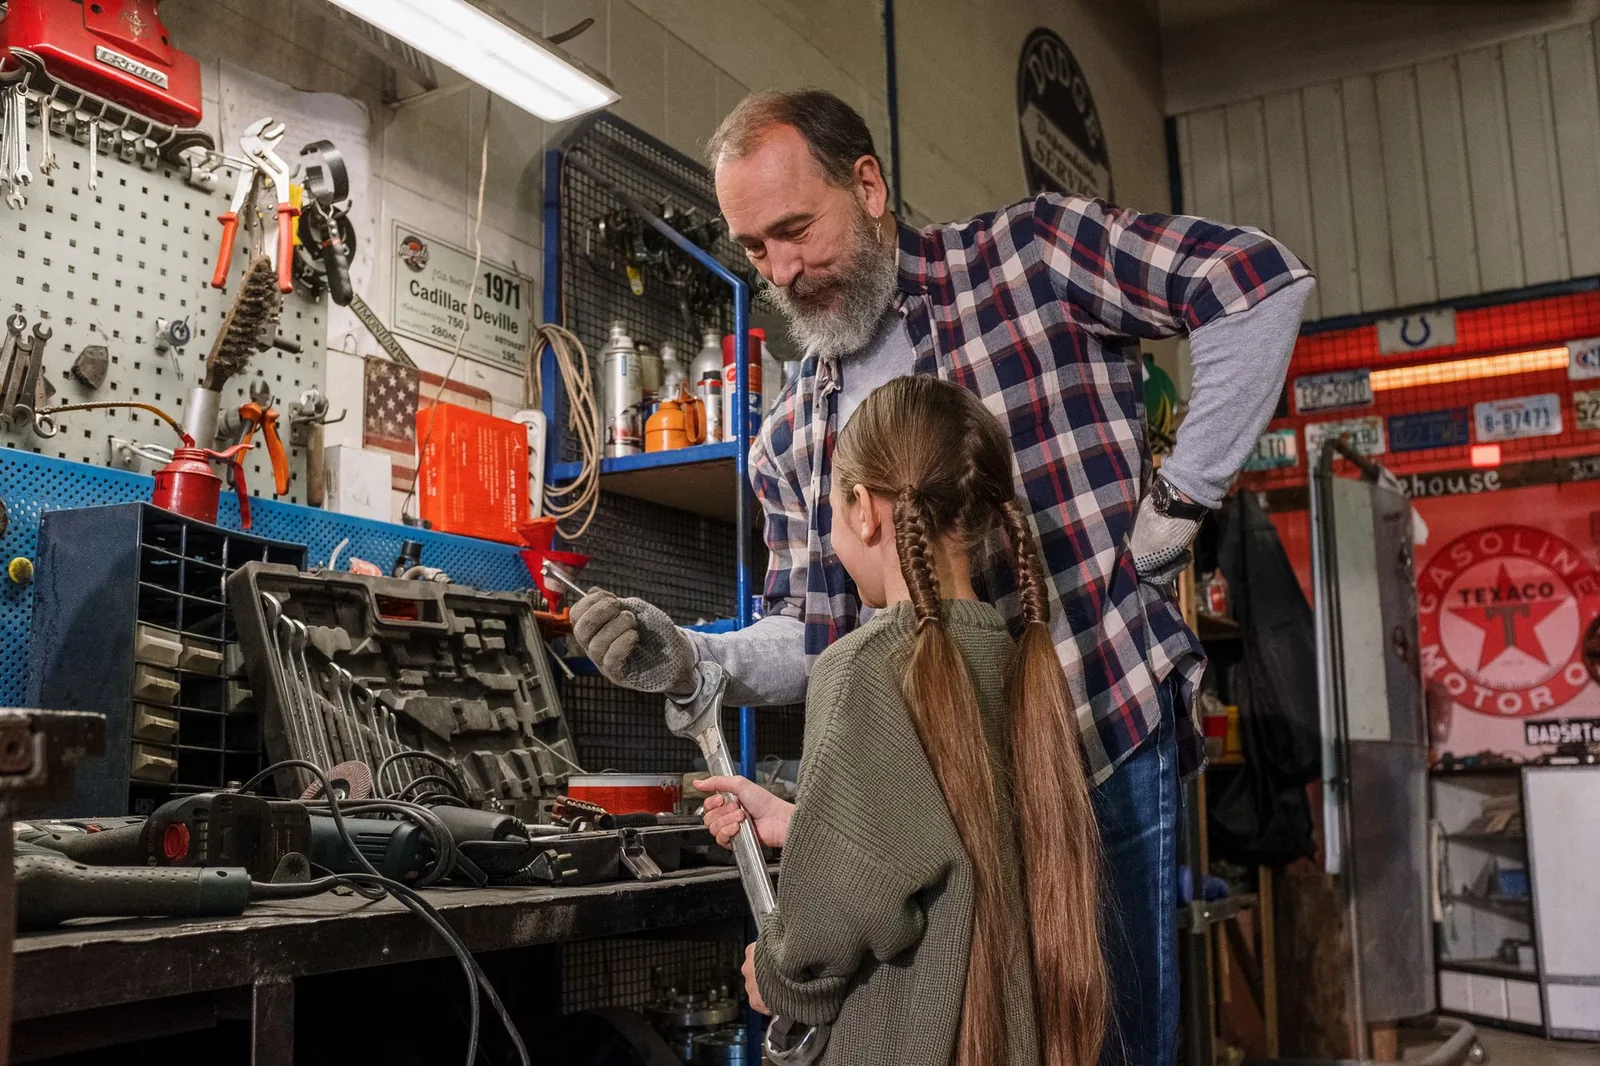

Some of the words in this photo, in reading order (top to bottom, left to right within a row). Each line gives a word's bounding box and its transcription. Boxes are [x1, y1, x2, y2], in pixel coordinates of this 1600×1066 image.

[1028, 42, 1101, 149] DODGE
[409, 279, 468, 316] Cadillac
[473, 303, 519, 334] Deville
[484, 272, 520, 310] 1971
[1420, 531, 1598, 615] GASOLINE
[1457, 582, 1555, 604] TEXACO
[1421, 644, 1555, 715] MOTOR
